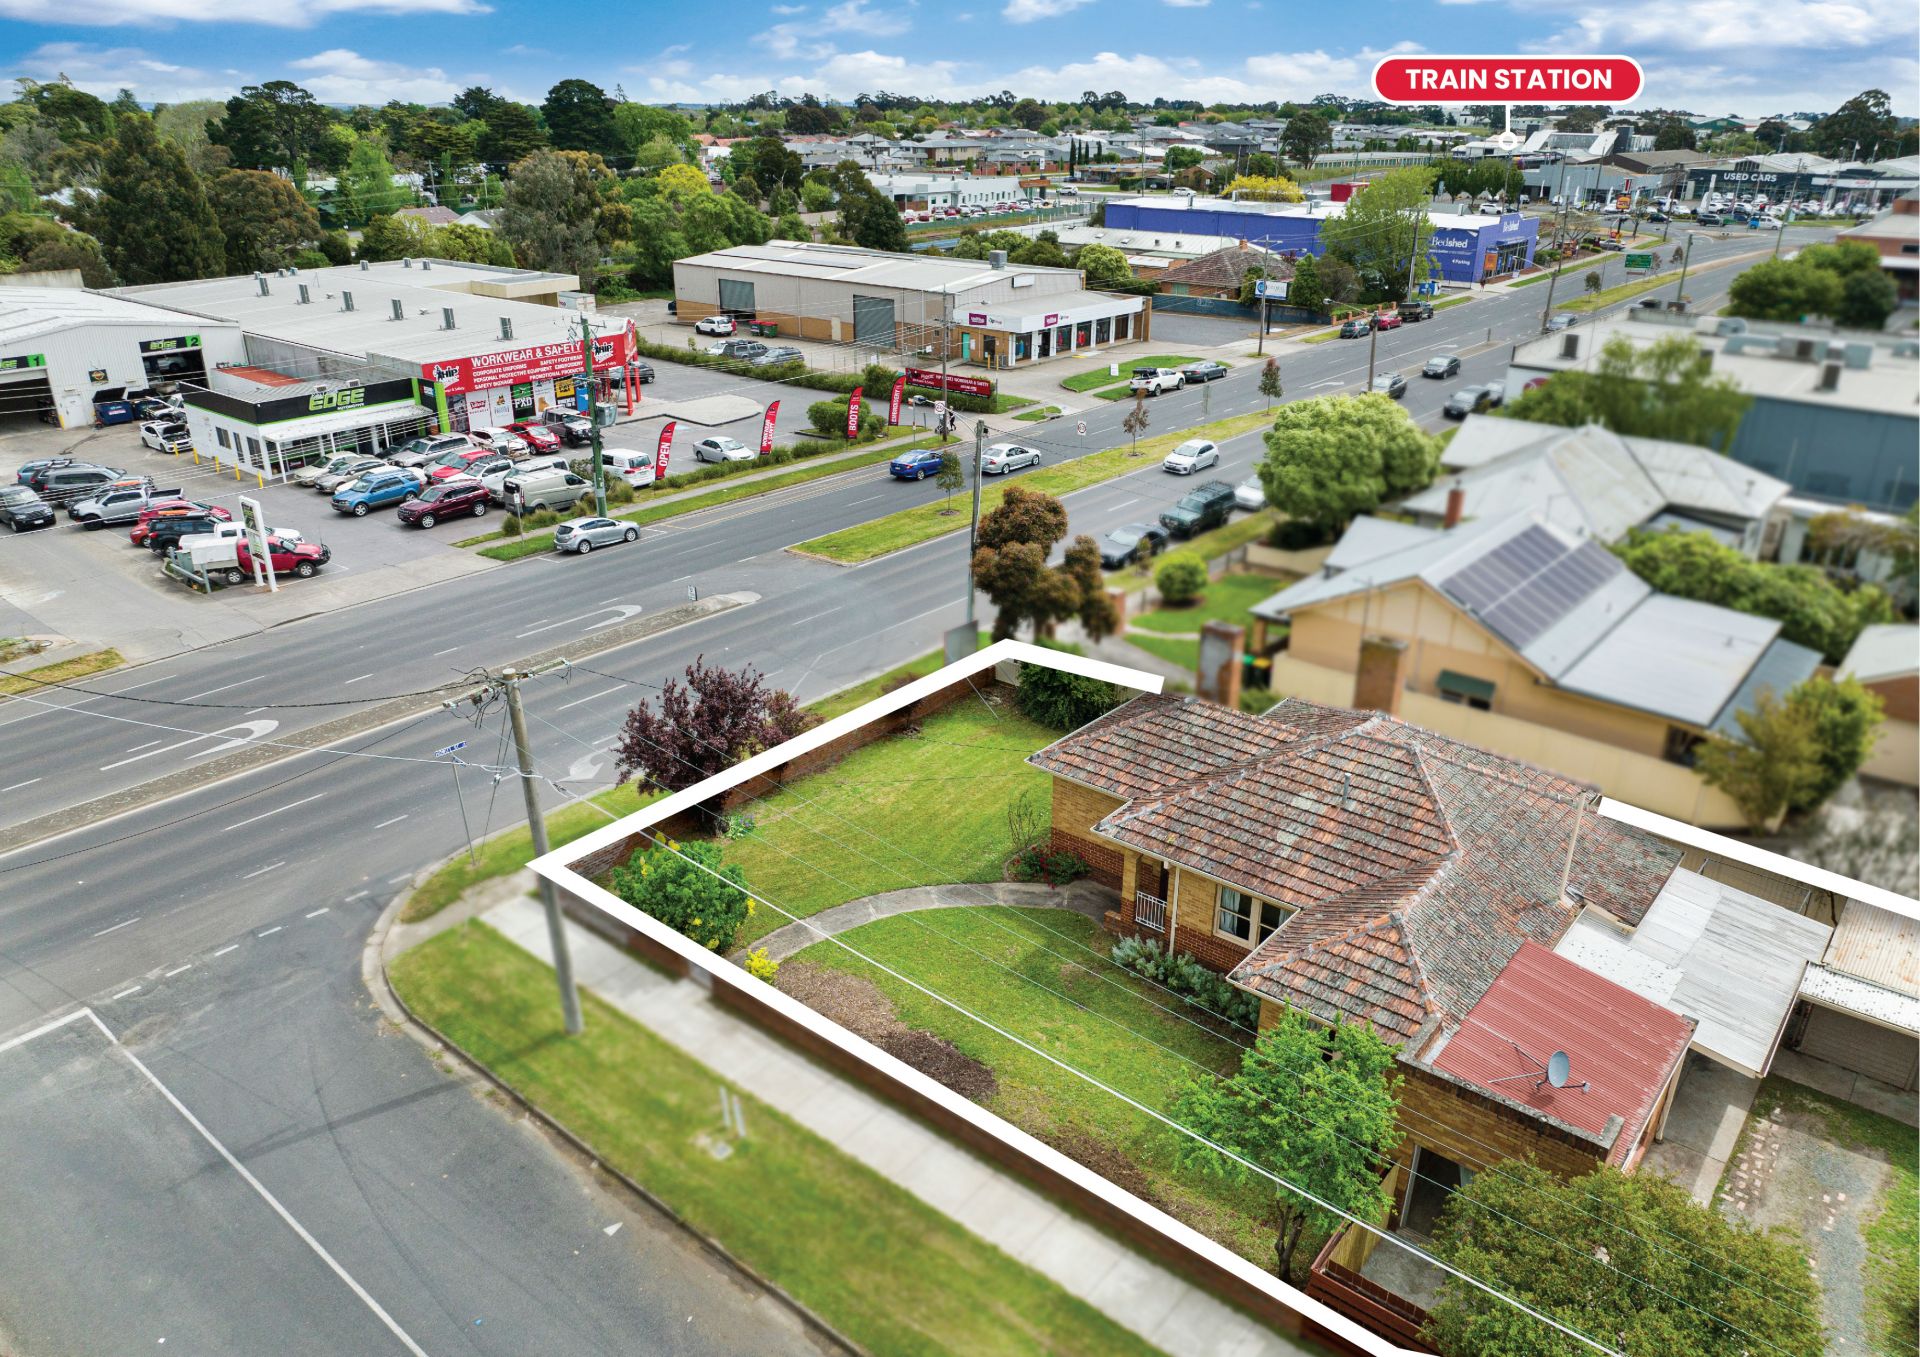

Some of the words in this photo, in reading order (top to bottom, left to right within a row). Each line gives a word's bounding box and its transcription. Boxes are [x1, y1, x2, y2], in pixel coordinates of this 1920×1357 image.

[1723, 172, 1749, 181] USED
[1750, 173, 1777, 182] CARS
[1432, 237, 1468, 248] Bedshed
[149, 340, 177, 350] EDGE
[190, 337, 199, 347] 2
[471, 349, 533, 368] WORKWEAR
[535, 347, 543, 358] &
[544, 341, 582, 356] SAFETY
[540, 358, 557, 366] SAFETY
[558, 354, 583, 363] FOOTWEAR
[33, 355, 40, 367] 1
[472, 367, 502, 377] CORPORATE
[473, 375, 499, 384] PERSONAL
[499, 370, 527, 379] PROTECTIVE
[529, 371, 561, 381] PROMOTIONAL
[474, 382, 492, 390] SAFETY
[309, 387, 365, 411] EDGE
[848, 404, 859, 431] BOOTS
[762, 419, 771, 447] WORKWEAR
[658, 442, 671, 467] OPEN
